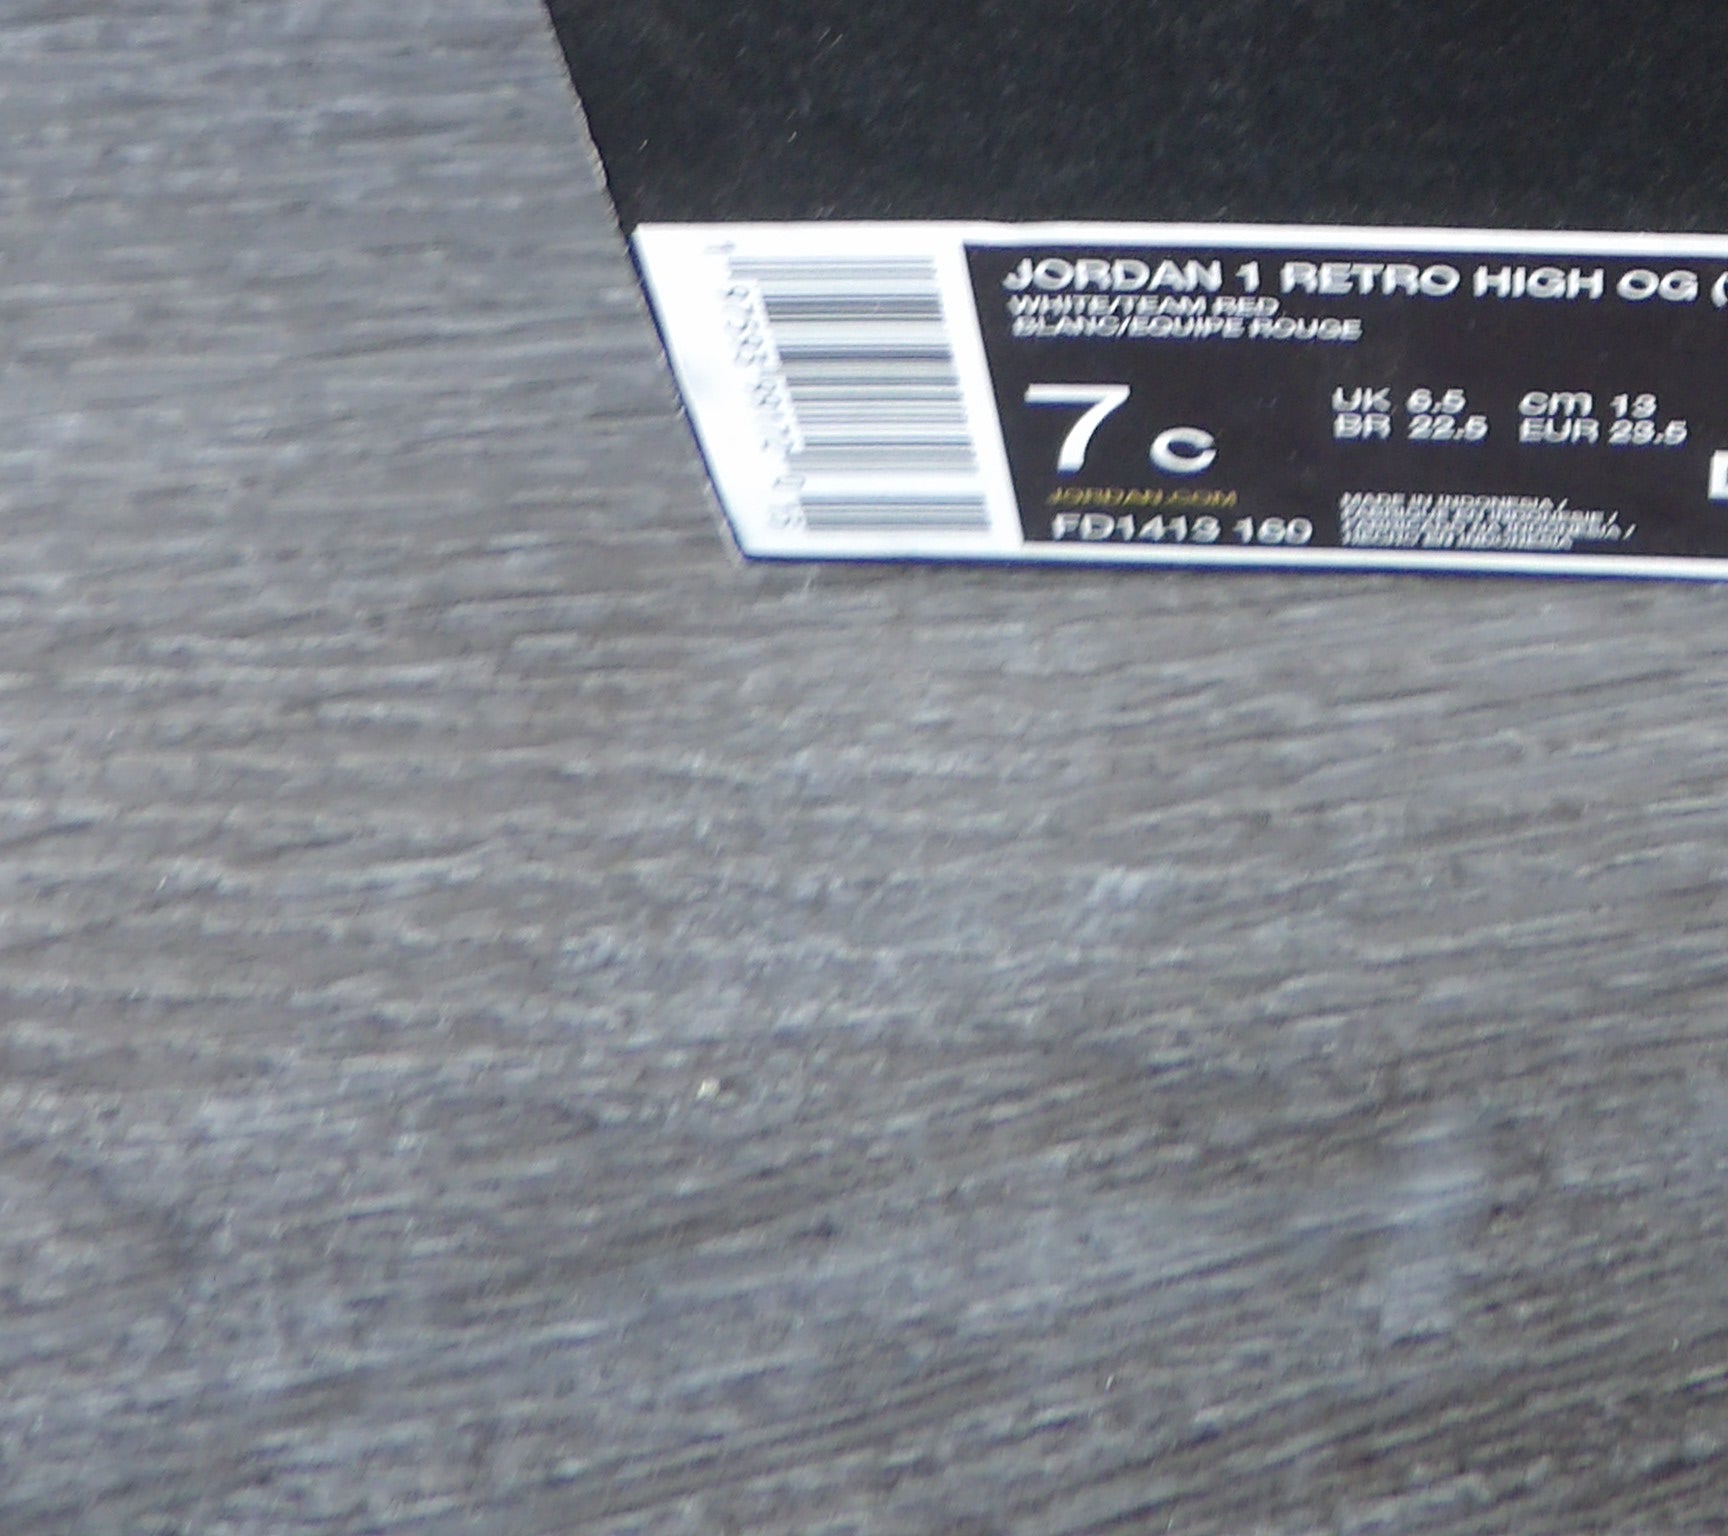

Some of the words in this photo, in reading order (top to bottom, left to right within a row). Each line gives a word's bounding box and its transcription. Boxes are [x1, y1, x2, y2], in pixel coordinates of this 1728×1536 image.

[1003, 258, 1223, 291] JORDAN
[1235, 260, 1260, 292] 1
[1280, 261, 1460, 296] RETRO
[1473, 264, 1604, 299] HIGH
[1616, 269, 1698, 301] OG
[1008, 295, 1206, 316] WHITE/TEAM
[1212, 296, 1280, 317] RED
[1248, 319, 1362, 342] ROUGE
[1332, 386, 1391, 412] UK
[1519, 391, 1593, 417] cm
[1024, 383, 1131, 474] 7
[1334, 413, 1391, 439] BR
[1408, 414, 1489, 441] 22.5
[1519, 417, 1599, 443] EUR
